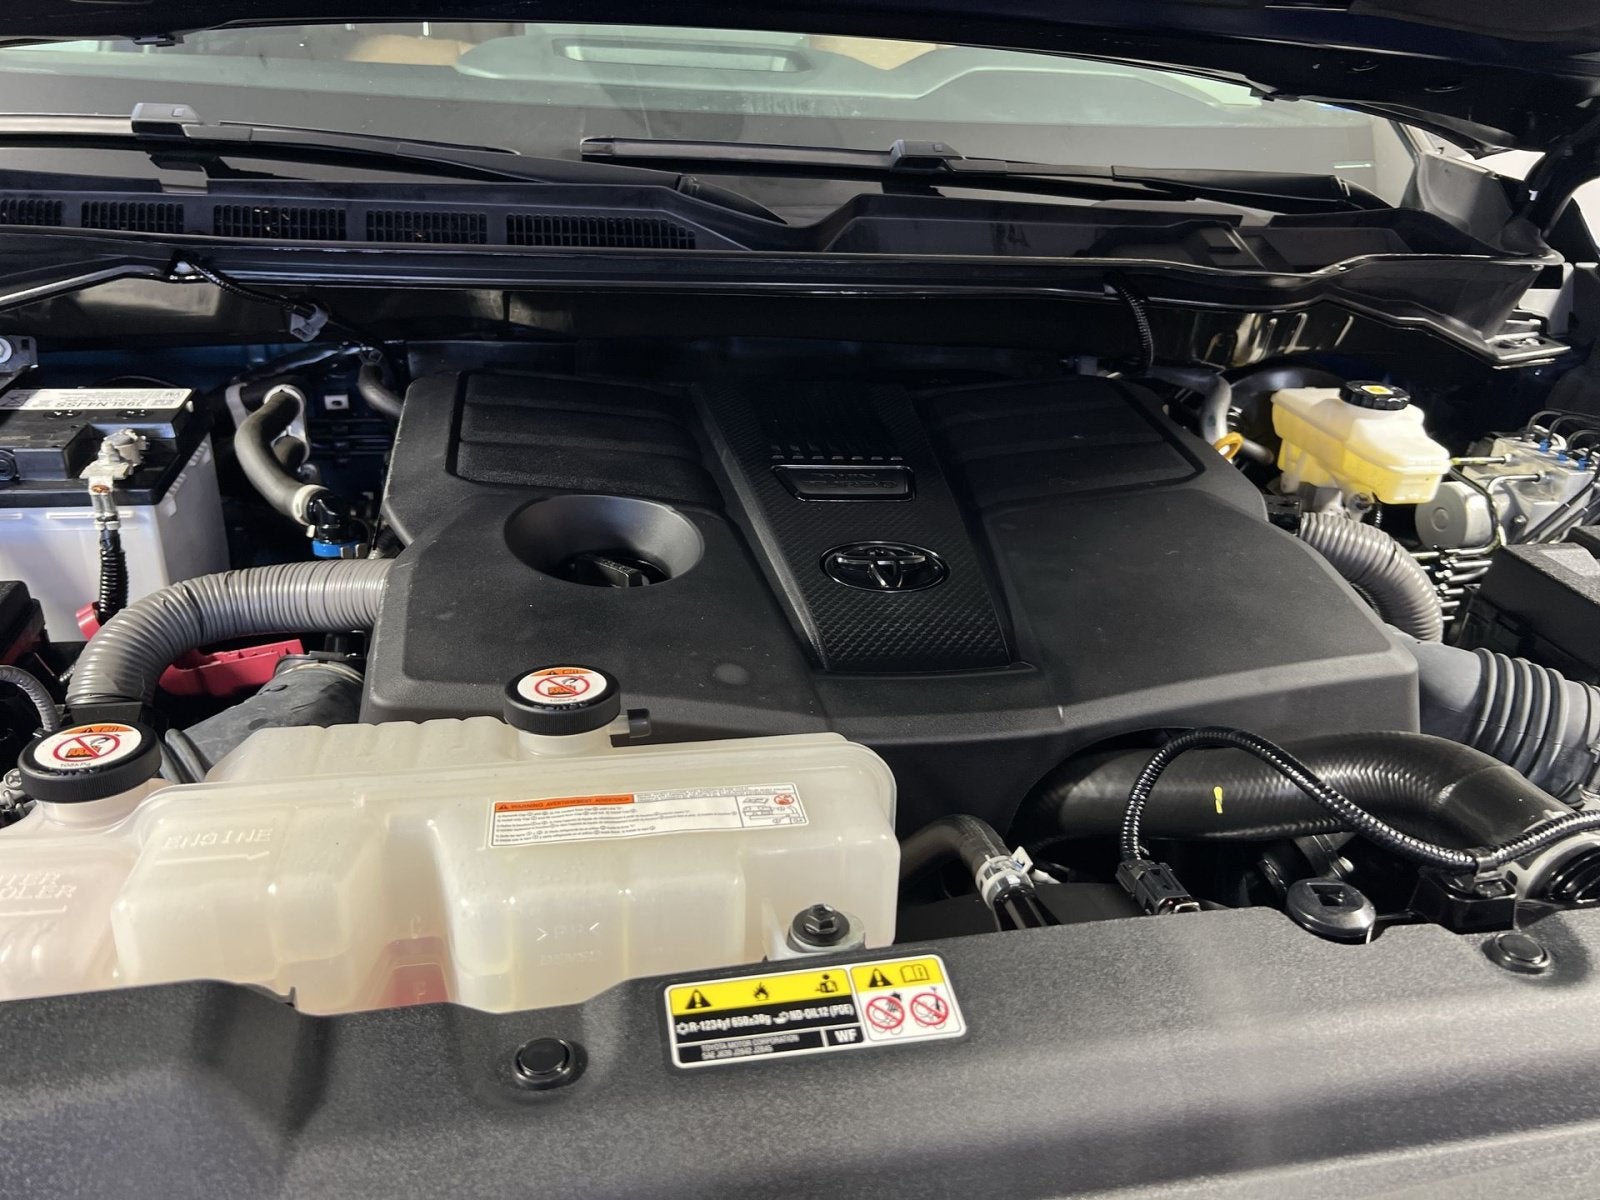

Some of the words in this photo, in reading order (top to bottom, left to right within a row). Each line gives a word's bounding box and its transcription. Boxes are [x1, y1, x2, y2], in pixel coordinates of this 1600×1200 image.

[511, 801, 544, 809] WARNING
[163, 829, 272, 848] ENGINE
[689, 1016, 731, 1032] R-1234yf
[701, 1042, 727, 1052] TOYOTA
[727, 1039, 751, 1049] MOTOR
[753, 1034, 800, 1047] CORPORATION
[835, 1029, 857, 1042] WF
